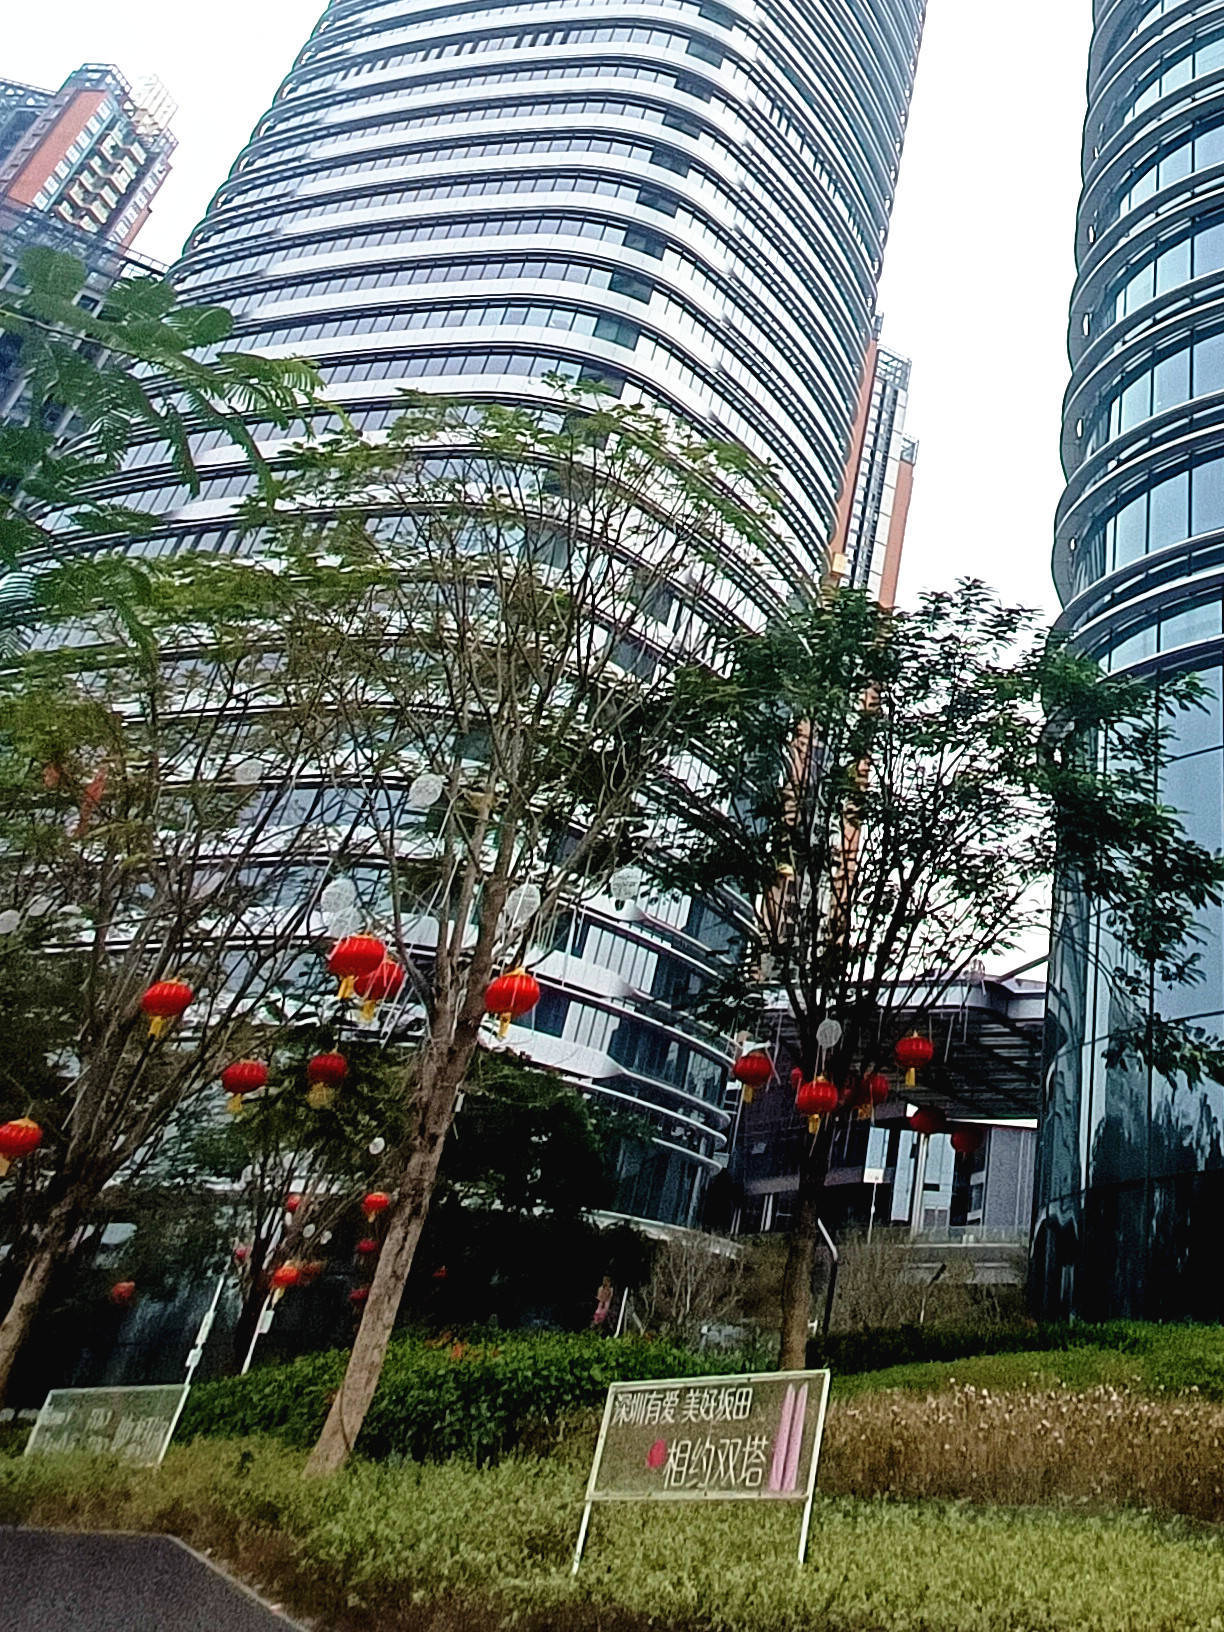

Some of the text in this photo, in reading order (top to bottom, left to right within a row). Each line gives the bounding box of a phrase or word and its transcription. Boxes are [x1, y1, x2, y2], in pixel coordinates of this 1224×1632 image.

[612, 1387, 752, 1426] 深圳有爱 美好坂田
[663, 1435, 768, 1489] 相约双塔
